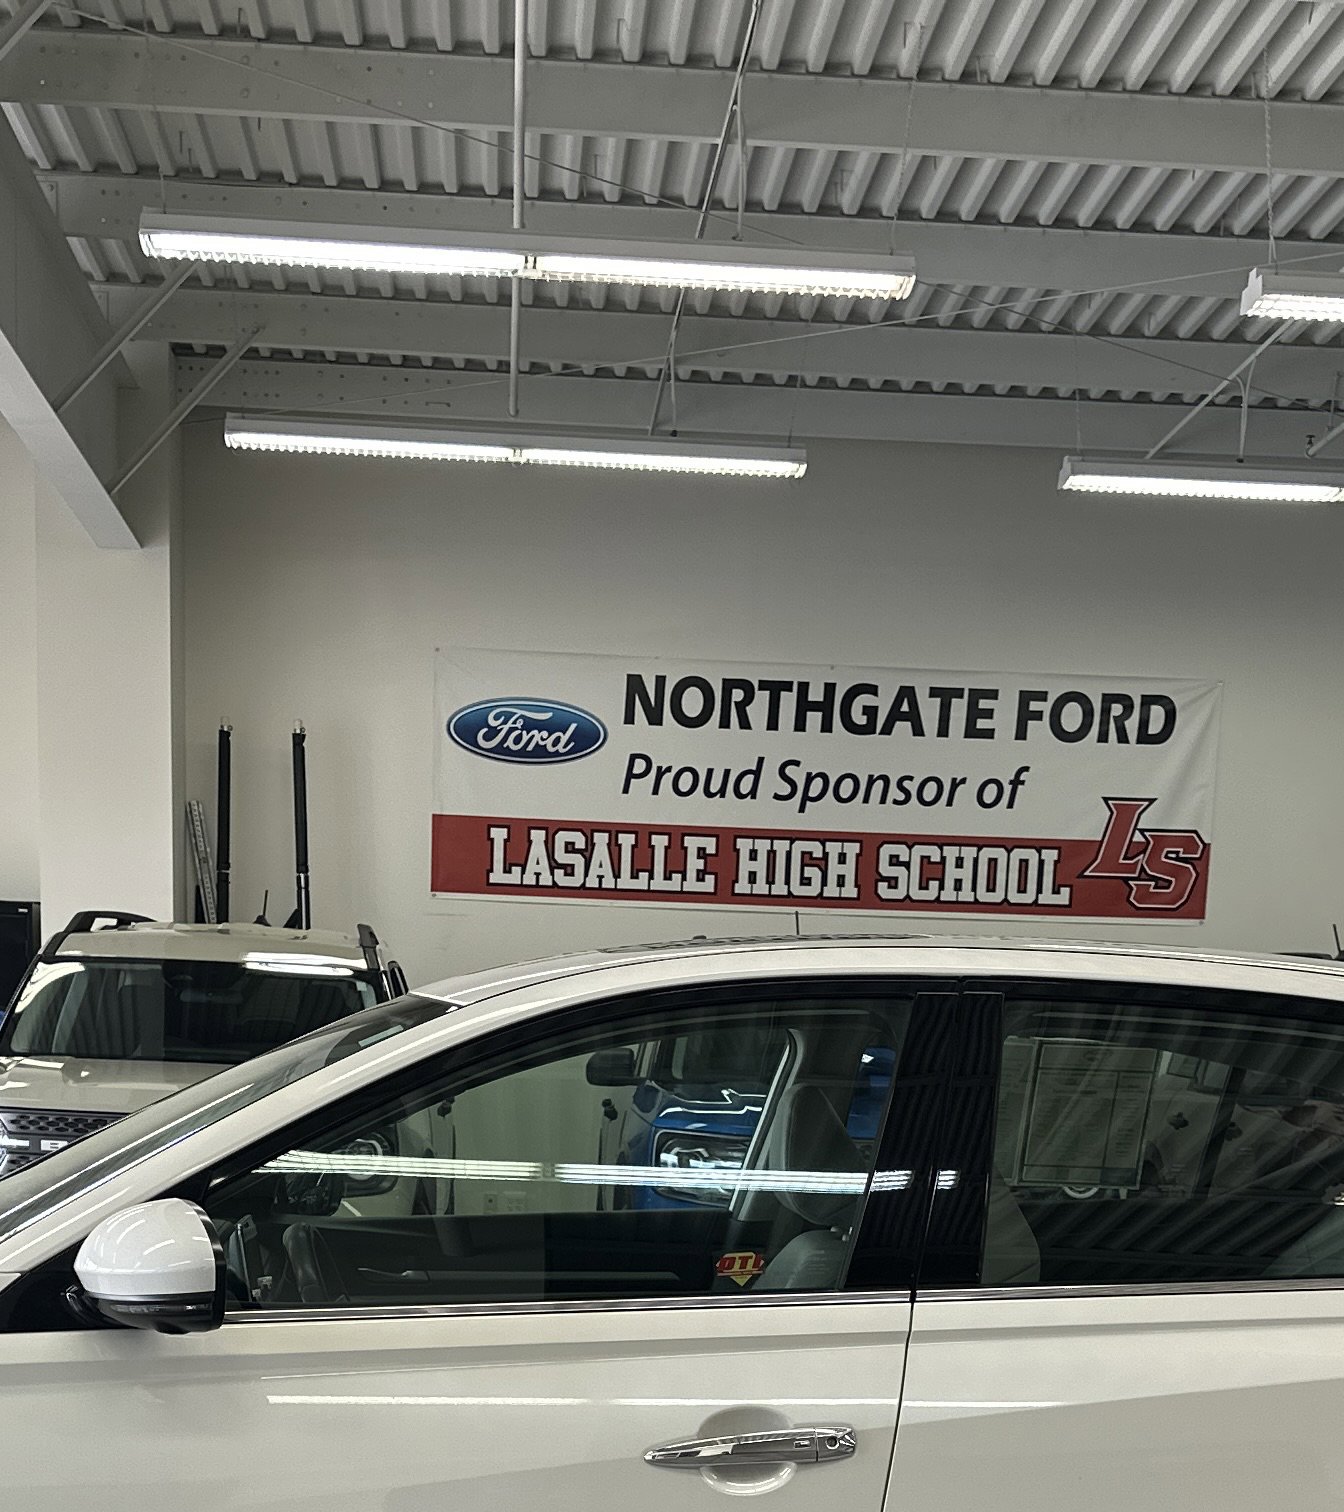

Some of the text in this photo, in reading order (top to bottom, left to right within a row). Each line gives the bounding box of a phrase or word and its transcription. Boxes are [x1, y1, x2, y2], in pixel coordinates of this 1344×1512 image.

[622, 673, 1178, 746] NORTHGATE FORD
[621, 752, 1031, 814] Proud Sponsor of
[486, 825, 1073, 908] LASALLE HIGH SCHOOL
[1077, 796, 1207, 912] LS
